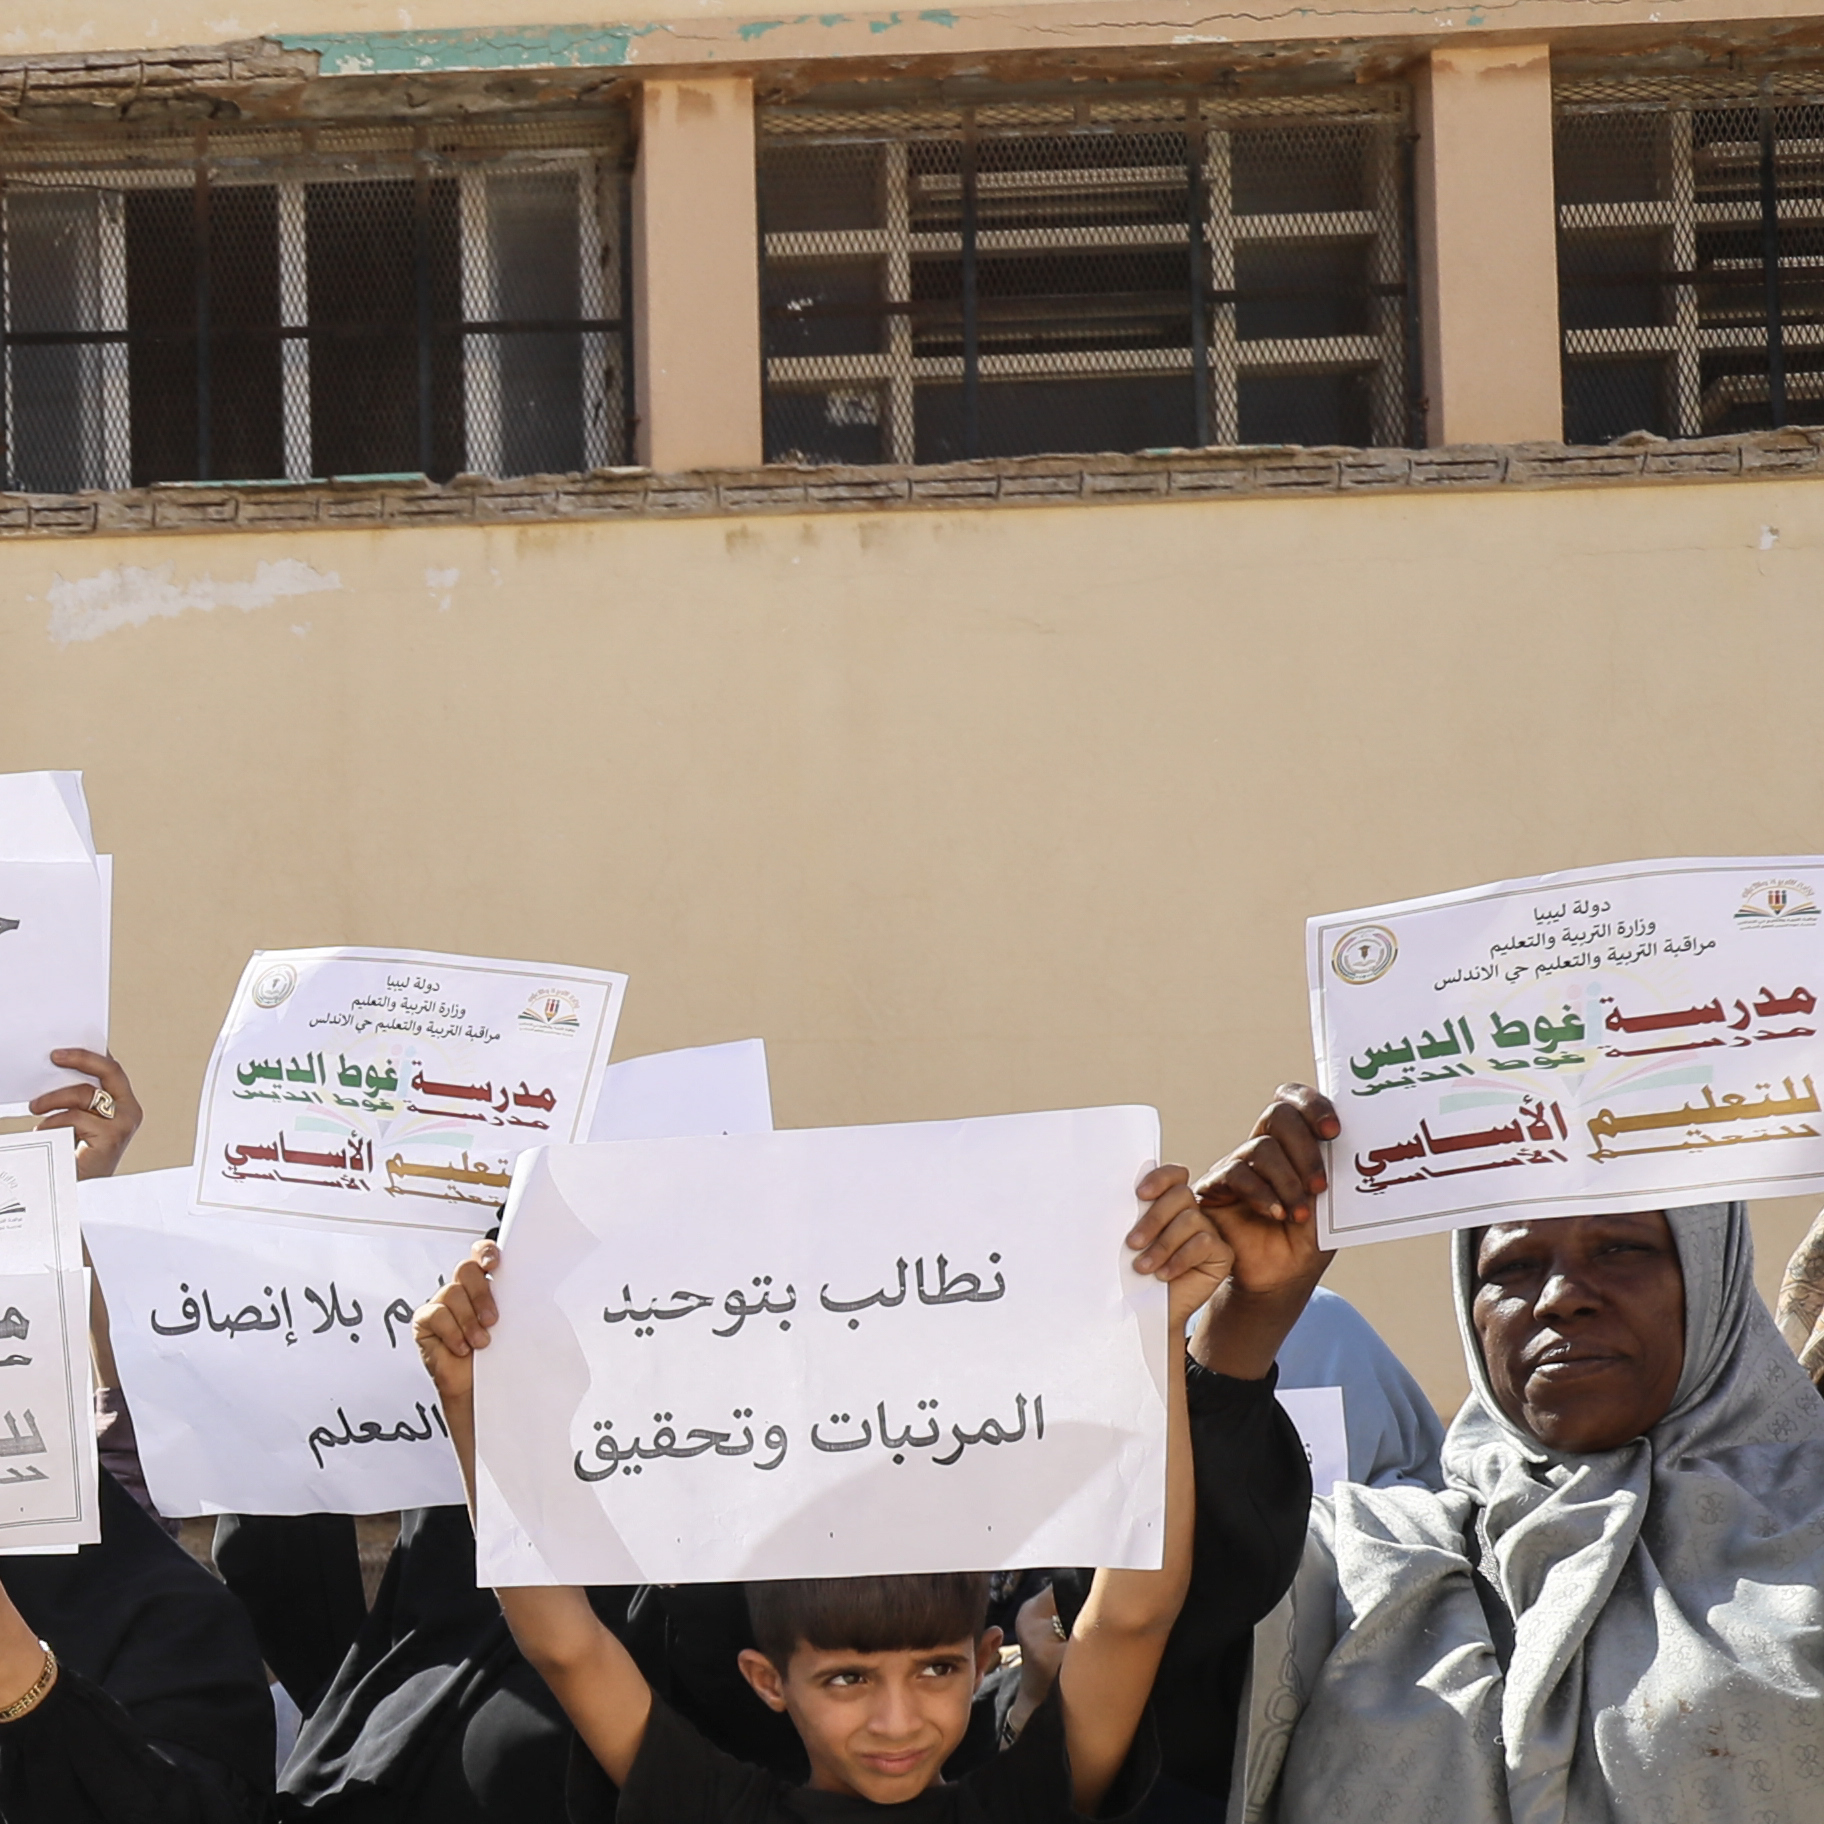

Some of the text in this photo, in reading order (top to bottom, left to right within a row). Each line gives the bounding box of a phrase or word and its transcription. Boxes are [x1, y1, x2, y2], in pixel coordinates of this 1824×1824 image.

[1490, 917, 1658, 960] وزارة التربية والتعليم
[1533, 900, 1611, 923] دولة ليبيا
[1349, 986, 1818, 1079] مدرسة غوط الديس
[237, 1051, 557, 1113] مدرسة غوط الديس
[1353, 1075, 1820, 1180] للتعليم الأساسي
[224, 1130, 511, 1194] تعليم الأساسي
[151, 1283, 298, 1347] إنصاف
[304, 1281, 363, 1343] بلا
[603, 1252, 1006, 1338] نطالب بتوحيد
[308, 1401, 449, 1469] المعلم
[574, 1392, 1044, 1482] المرتبات وتحقيق
